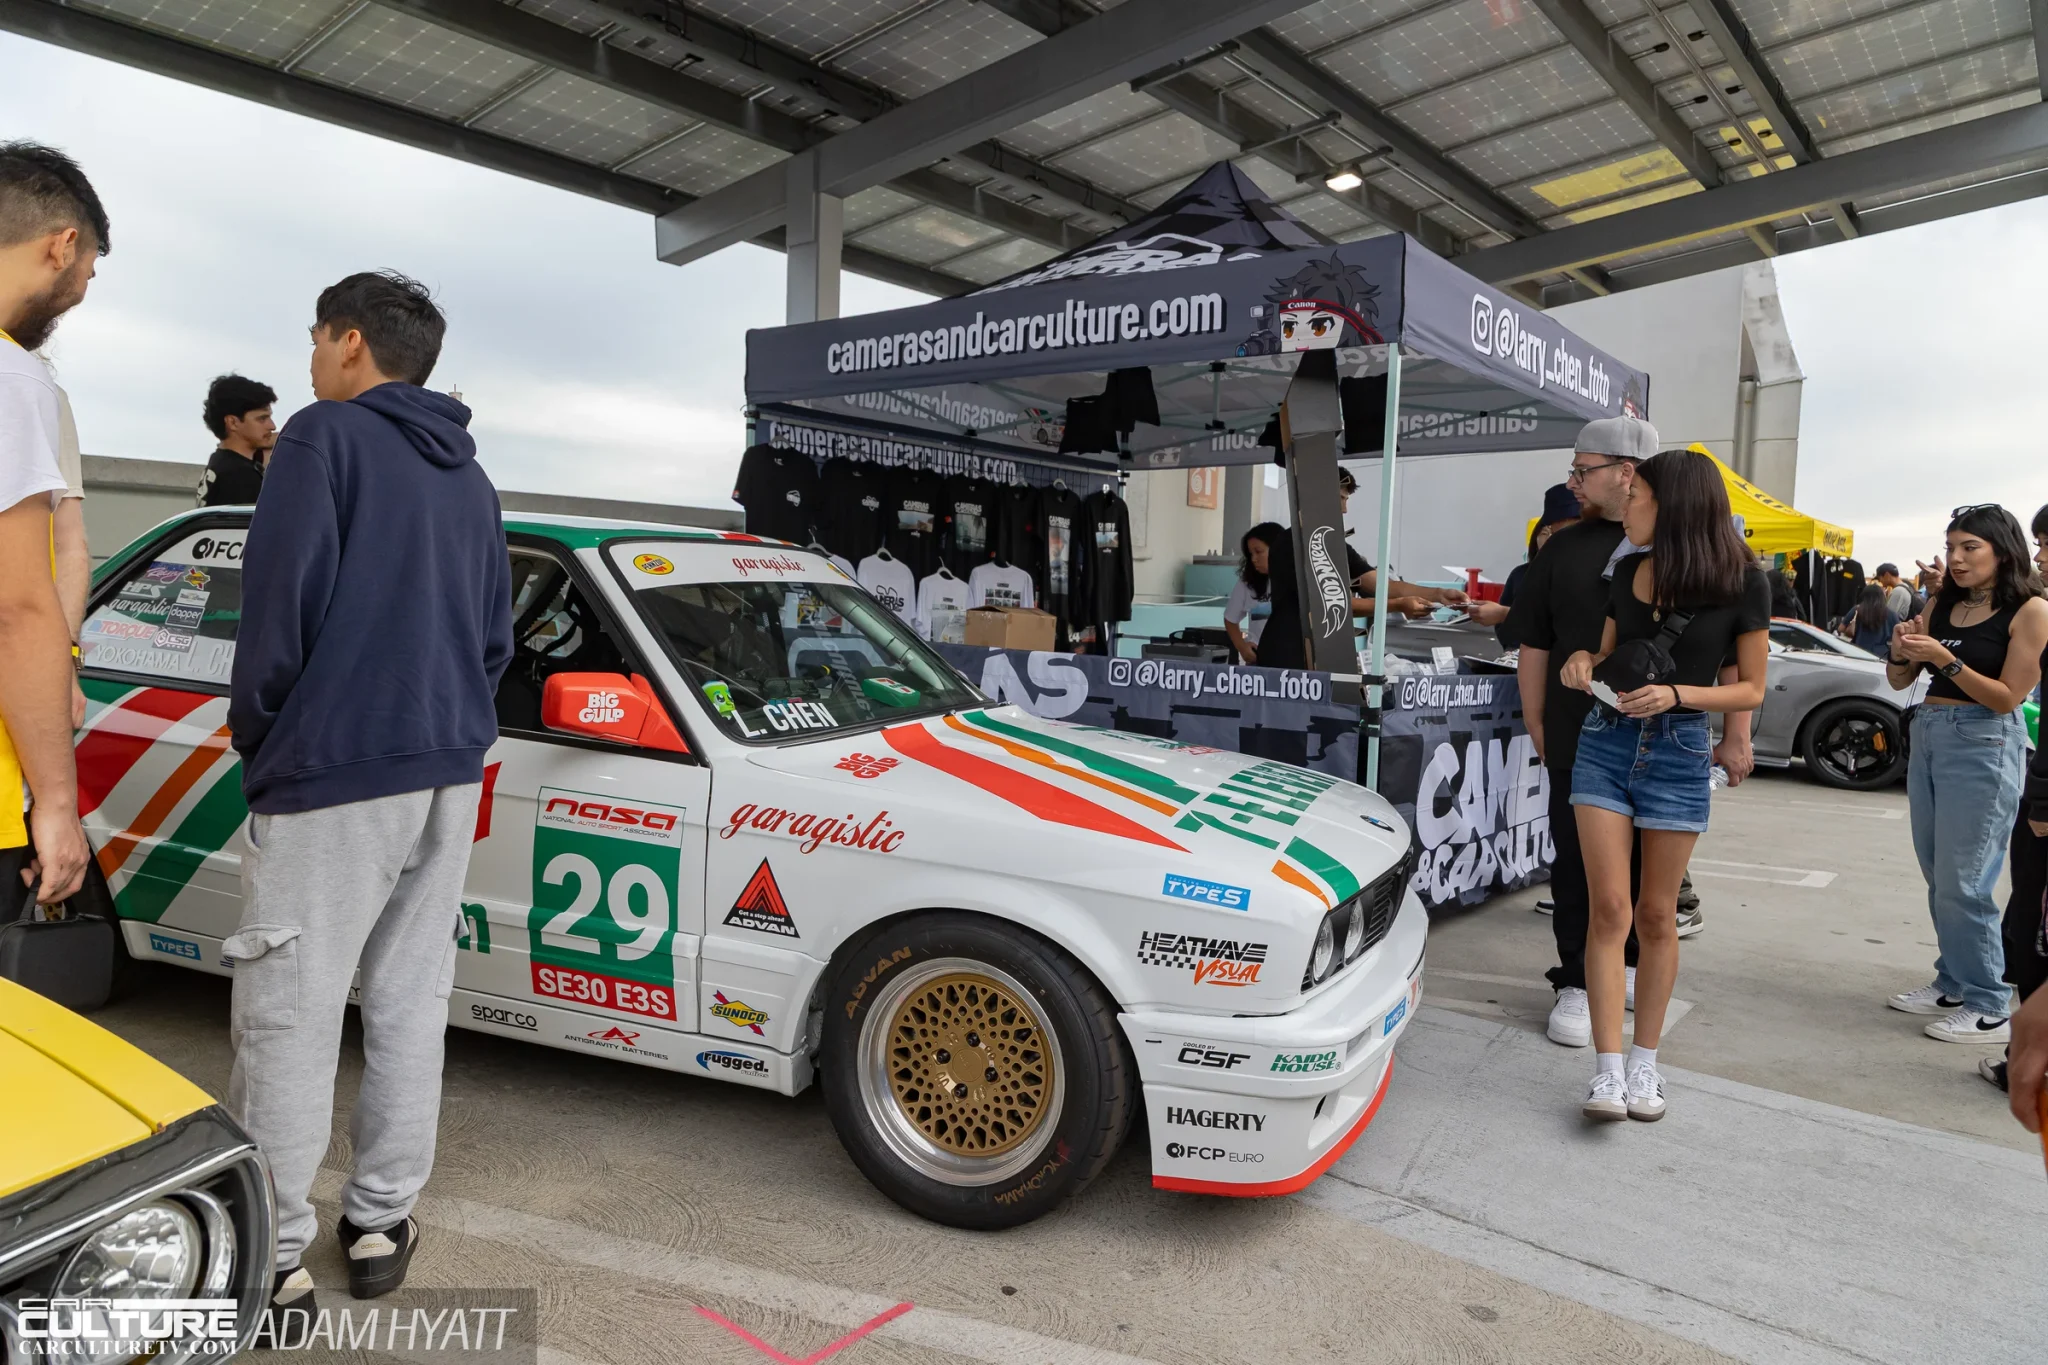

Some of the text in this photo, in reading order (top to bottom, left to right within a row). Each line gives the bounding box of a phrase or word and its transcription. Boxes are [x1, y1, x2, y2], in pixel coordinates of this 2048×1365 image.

[828, 292, 1223, 374] camerasandcarculture.com
[1495, 308, 1611, 408] @larry_chen_foto
[212, 541, 244, 561] FC
[732, 554, 806, 577] garagistic
[108, 598, 172, 619] garagistic
[171, 607, 202, 620] dapper
[100, 620, 157, 639] TORQUE
[96, 644, 181, 671] YOKOHAMA
[1134, 660, 1323, 701] @larry_chen_foto
[1416, 677, 1494, 713] @larry_chen_foto
[578, 708, 625, 723] GULP
[764, 702, 839, 731] CHEN
[545, 797, 678, 831] nasa
[542, 814, 671, 839] NATIONAL AUTO SPORT ASSOCIATION
[719, 803, 905, 855] garagistic
[540, 852, 670, 961] 29
[728, 916, 795, 936] ADVAN
[767, 915, 785, 923] ahead
[1141, 930, 1269, 964] HEATWAVE
[538, 968, 670, 1016] SE30 E3S
[844, 946, 913, 1020] ADVAN
[471, 1004, 538, 1028] sparco
[713, 1005, 767, 1025] SUNOCO
[564, 1034, 669, 1061] ANTIGRAVITY BATTERIES
[1177, 1047, 1252, 1069] CSF
[1183, 1042, 1207, 1050] COOLED
[1274, 1051, 1337, 1064] KAIDO
[1269, 1060, 1335, 1073] HOUSE
[1166, 1106, 1267, 1133] HAGERTY
[1187, 1145, 1265, 1163] FCP EURO
